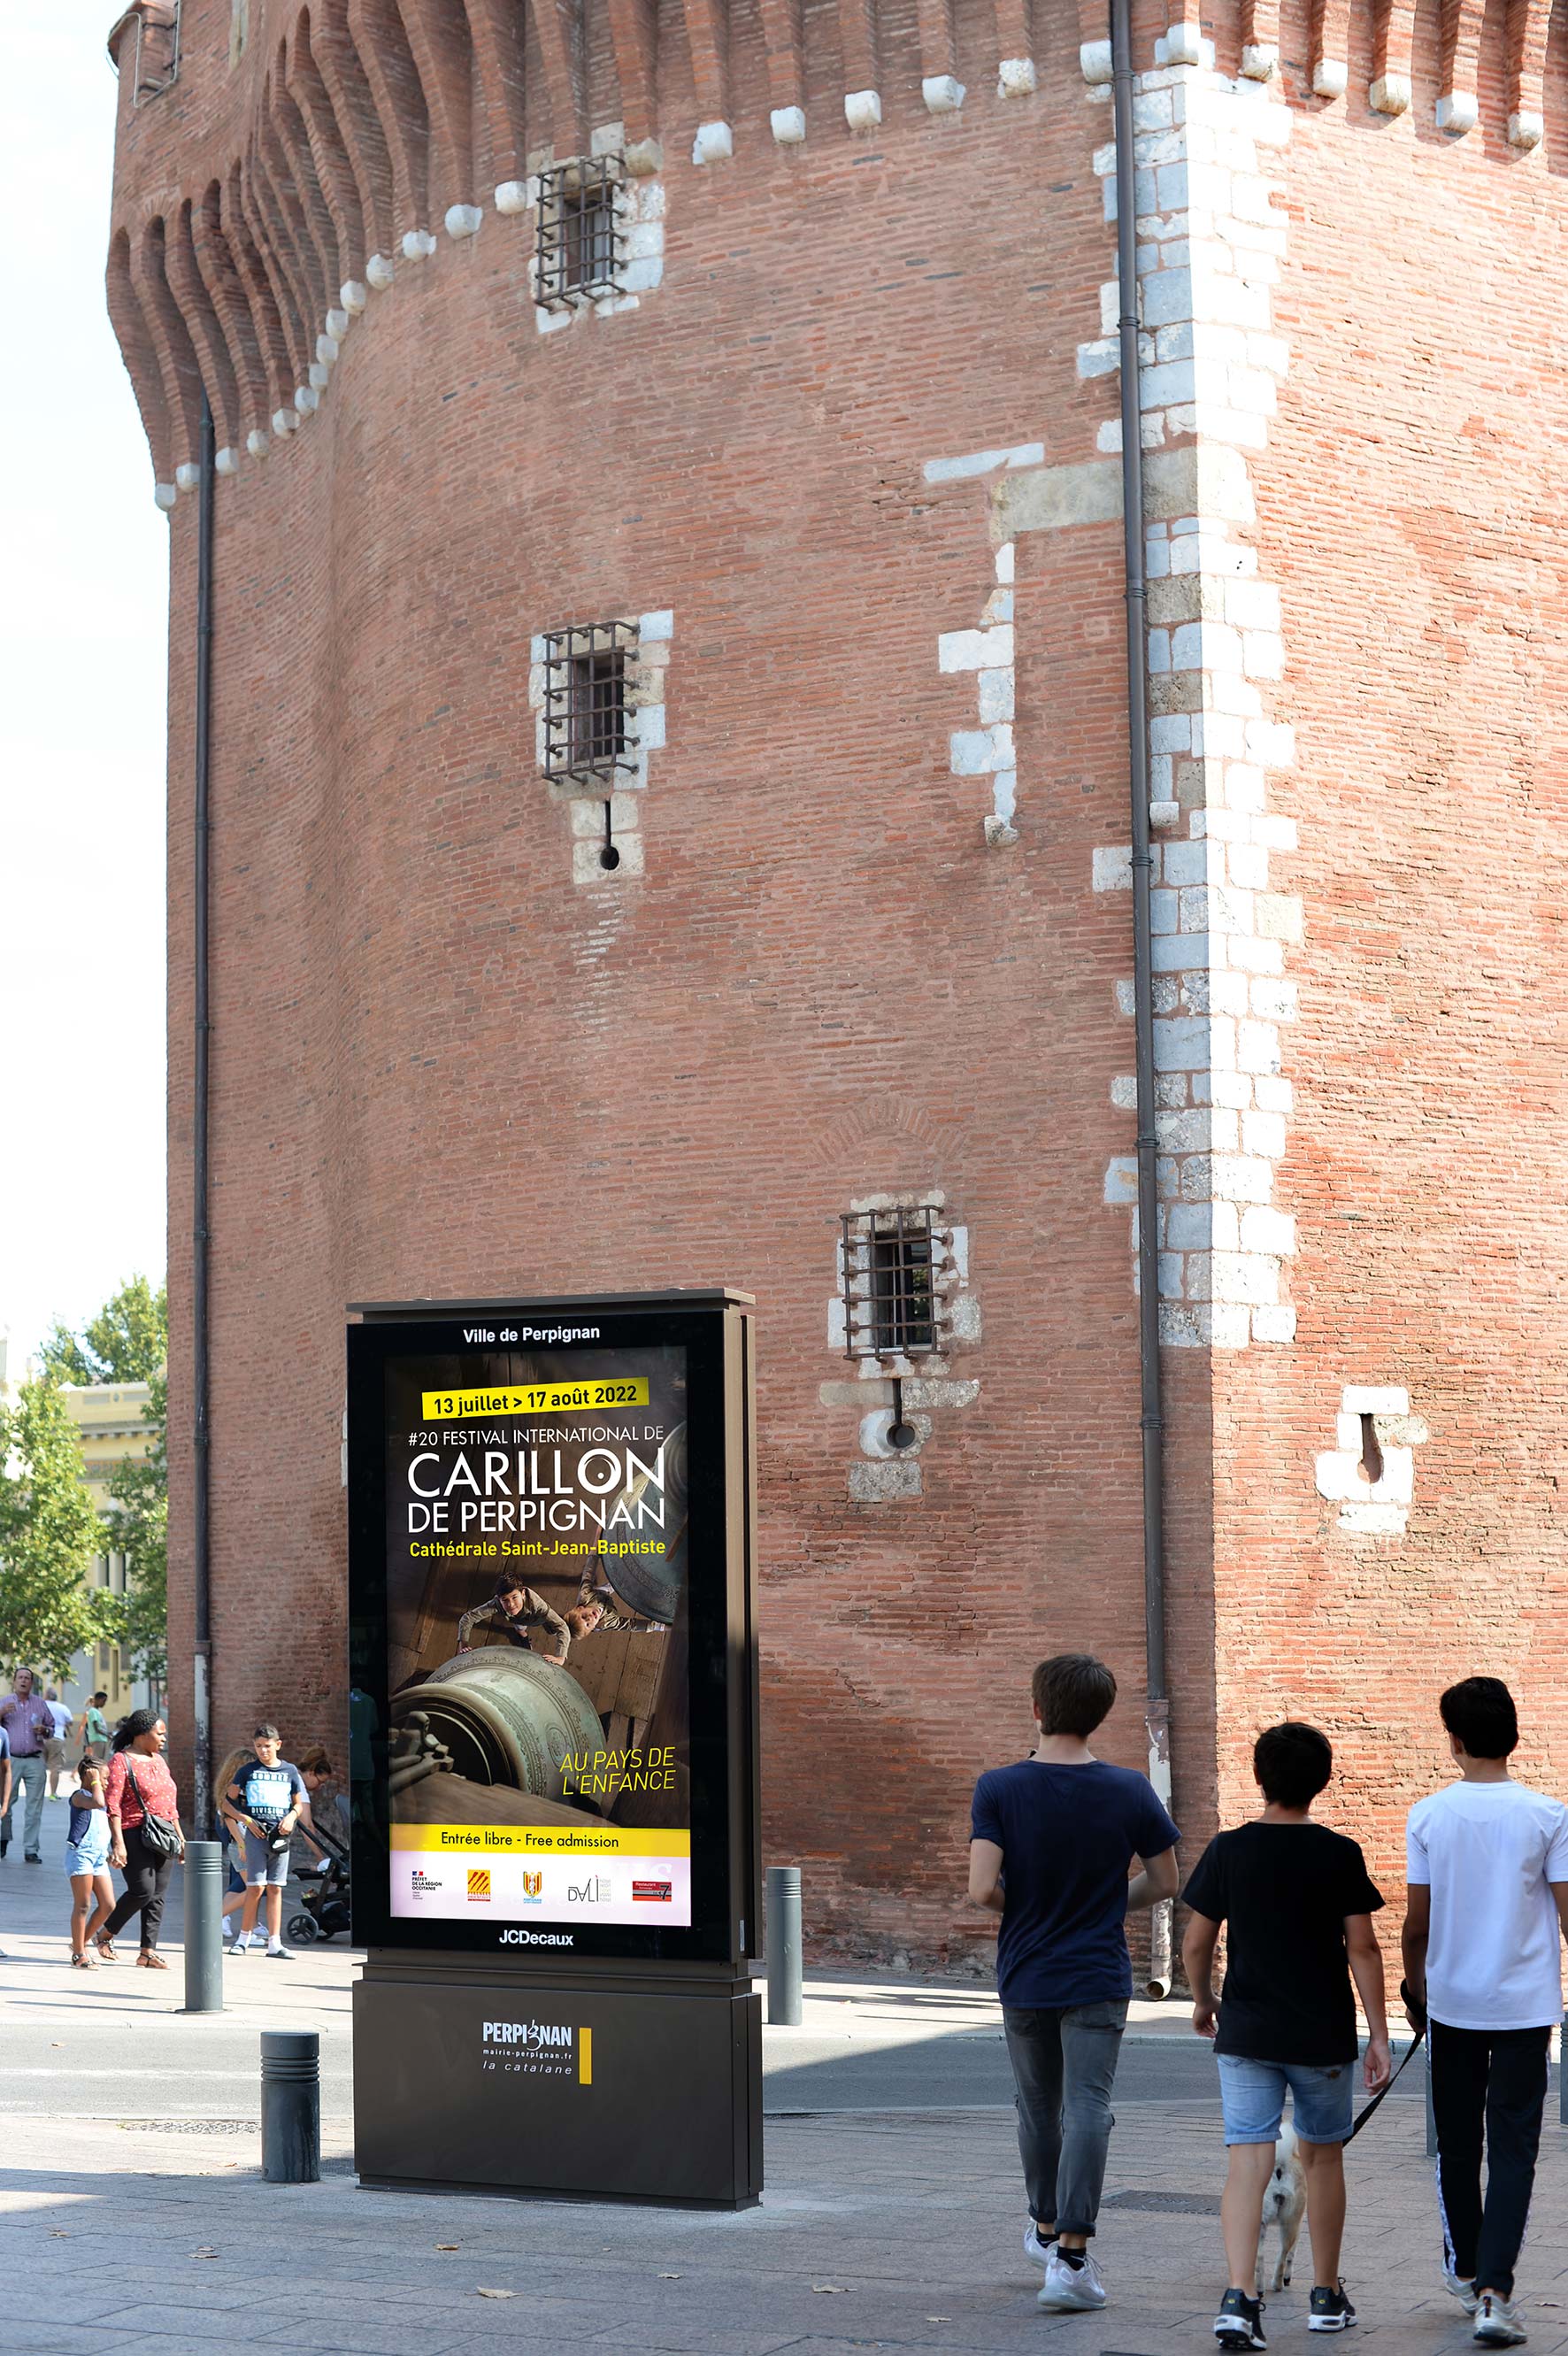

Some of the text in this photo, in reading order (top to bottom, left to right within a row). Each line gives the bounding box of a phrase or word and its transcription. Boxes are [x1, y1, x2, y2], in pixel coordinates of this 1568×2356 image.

[464, 1326, 600, 1344] Ville de Perpignan
[434, 1397, 454, 1415] 13
[457, 1395, 508, 1416] juillet
[528, 1392, 547, 1409] 17
[551, 1389, 590, 1408] août
[595, 1385, 637, 1404] 2022
[408, 1426, 664, 1446] #20 FESTIVAL INTERNATIONAL DE
[408, 1447, 665, 1498] CARILLON
[408, 1498, 665, 1533] DE PERPIGNAN
[410, 1538, 665, 1558] Cathédrale Saint-Jean-Baptiste
[559, 1747, 676, 1772] AU PAYS DE
[563, 1770, 677, 1795] L'ENFANCE
[442, 1832, 481, 1845] Entrée
[485, 1831, 512, 1845] libre
[526, 1833, 553, 1847] Free
[557, 1833, 619, 1848] admission
[499, 1929, 574, 1946] JCDecaux
[483, 2048, 573, 2060] mairie-perpignan.fr
[483, 2060, 573, 2075] la catalane
